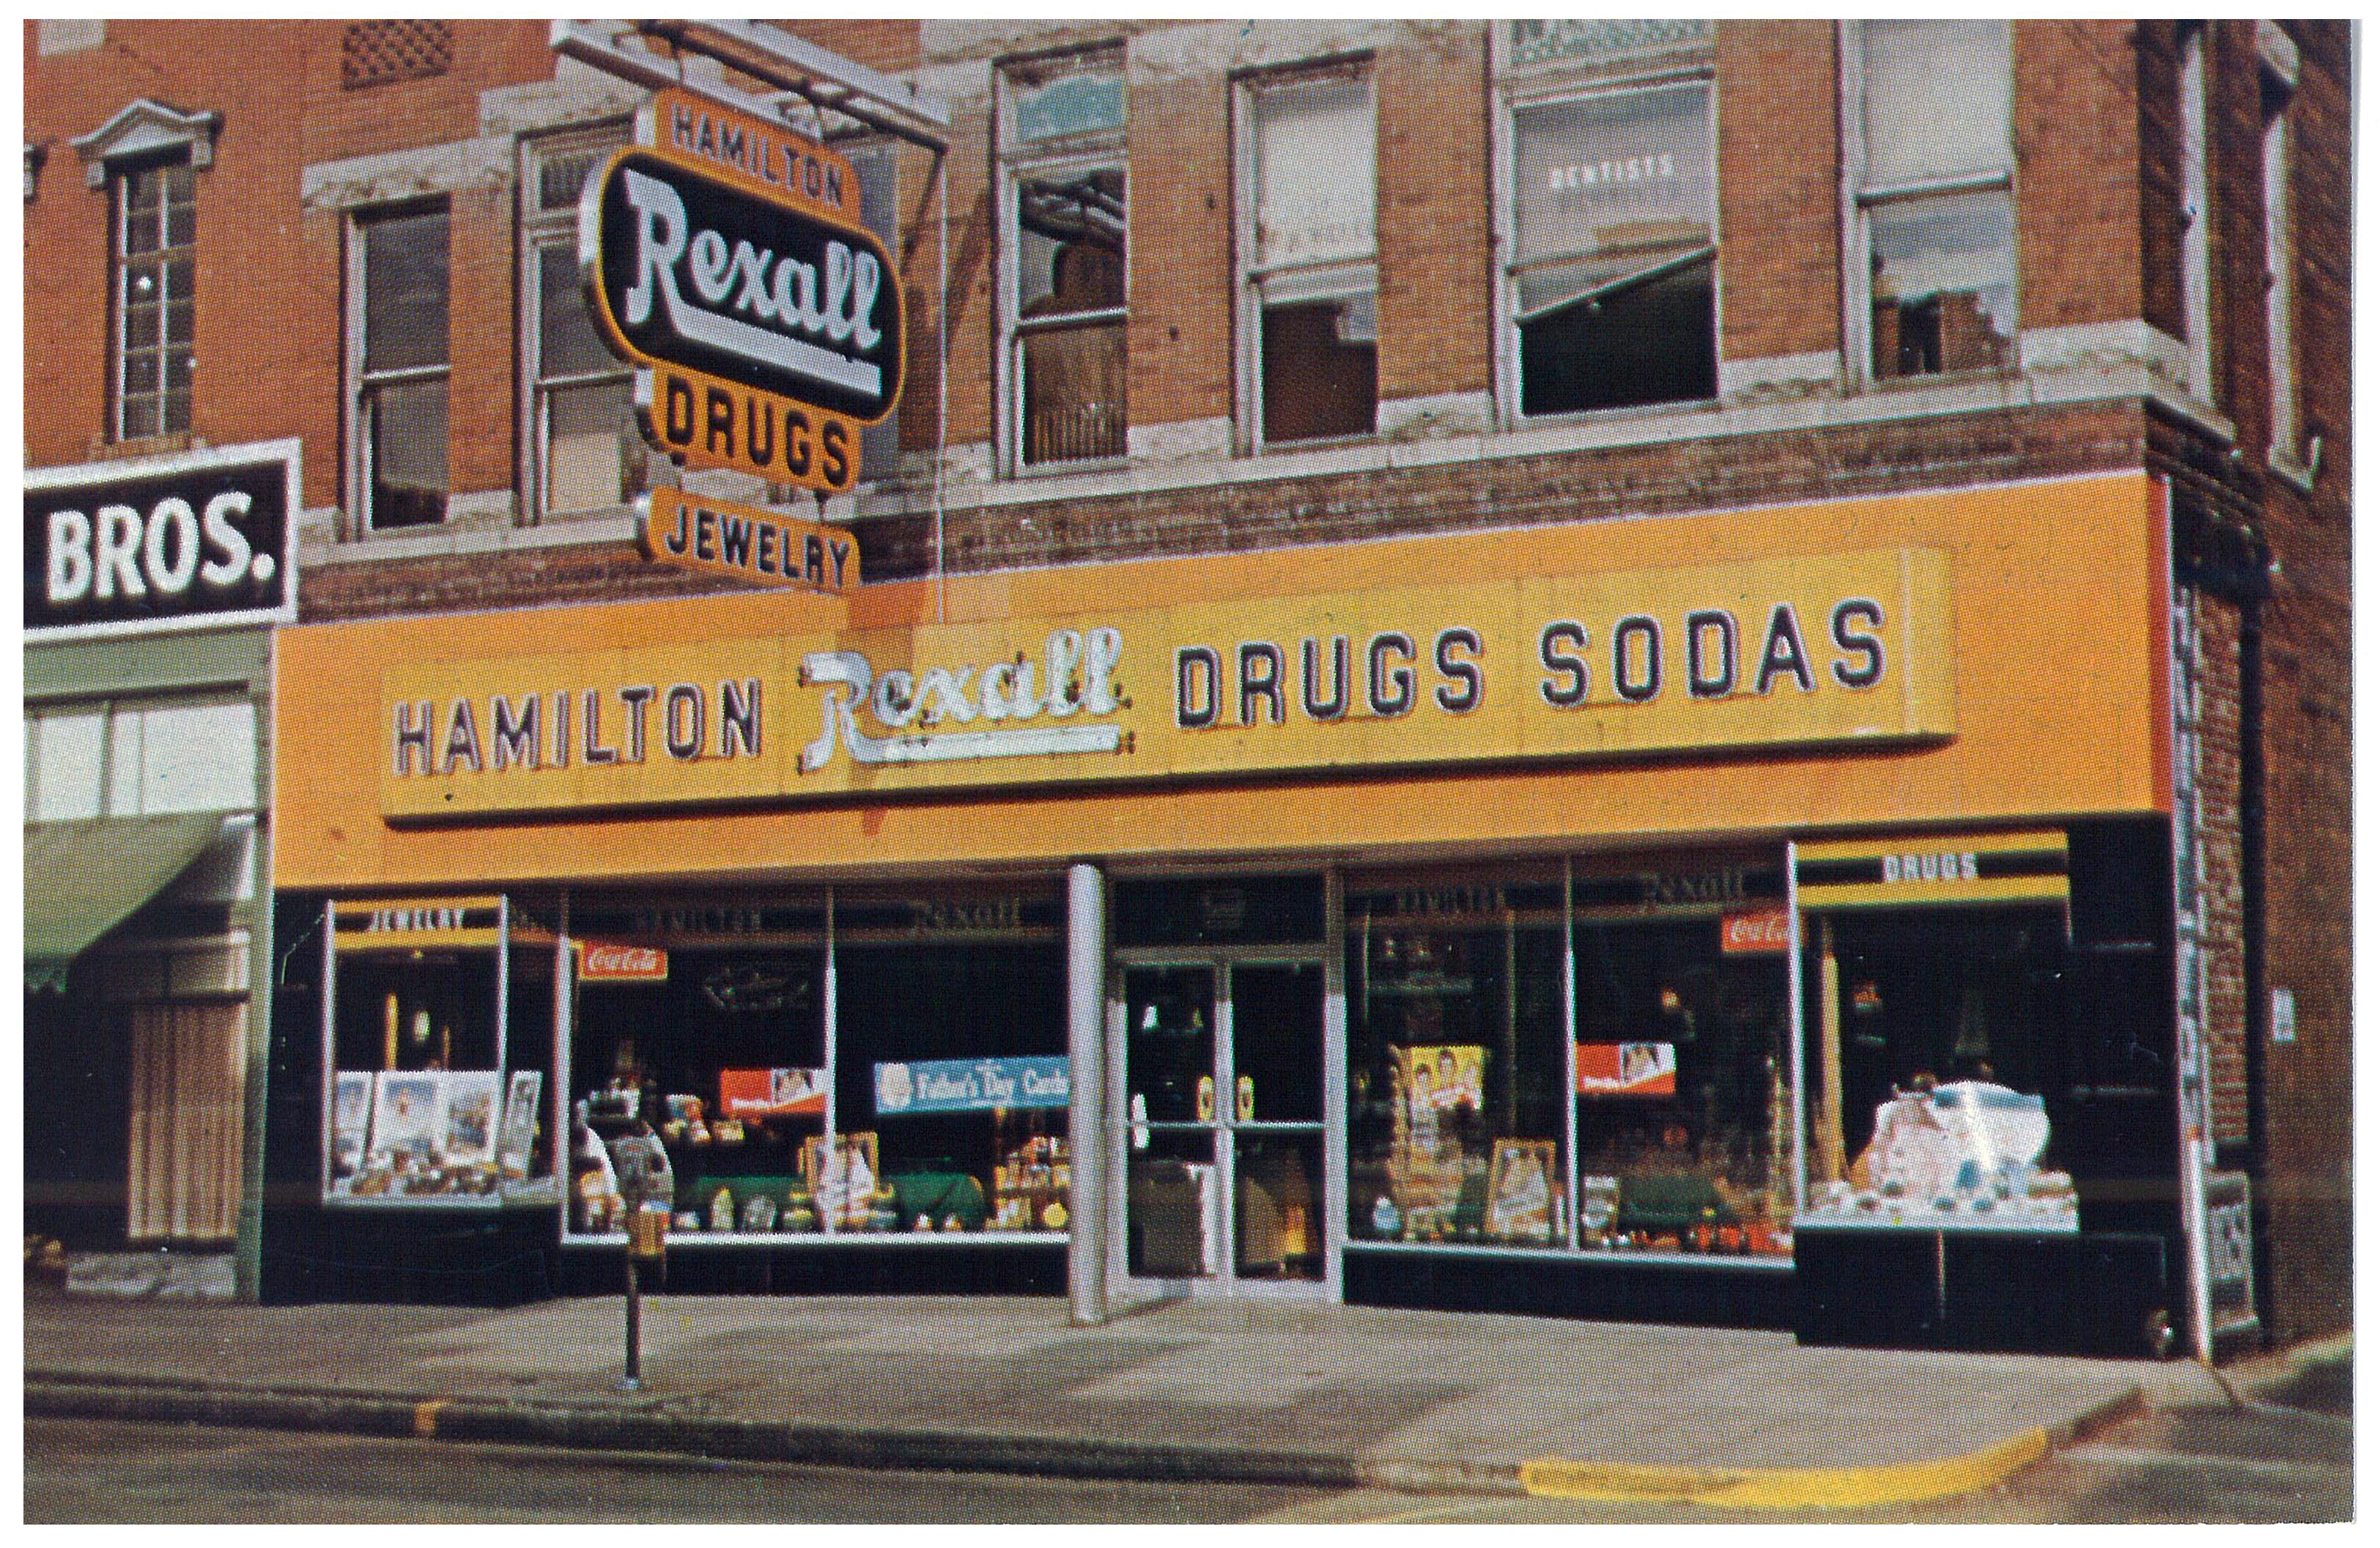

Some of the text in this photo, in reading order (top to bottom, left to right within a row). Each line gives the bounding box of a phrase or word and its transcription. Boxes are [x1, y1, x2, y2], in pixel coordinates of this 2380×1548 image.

[670, 102, 843, 209] HAMILTON
[1551, 154, 1674, 189] DENTISTS
[624, 167, 882, 397] Rexall
[666, 375, 849, 488] DRUGS
[49, 491, 275, 601] BROS.
[665, 503, 851, 587] JEWELRY
[391, 596, 1887, 776] HAMILTON Rexall DRUGS SODAS
[369, 908, 465, 933] JEWELRY
[1882, 852, 1978, 883] DRUGS
